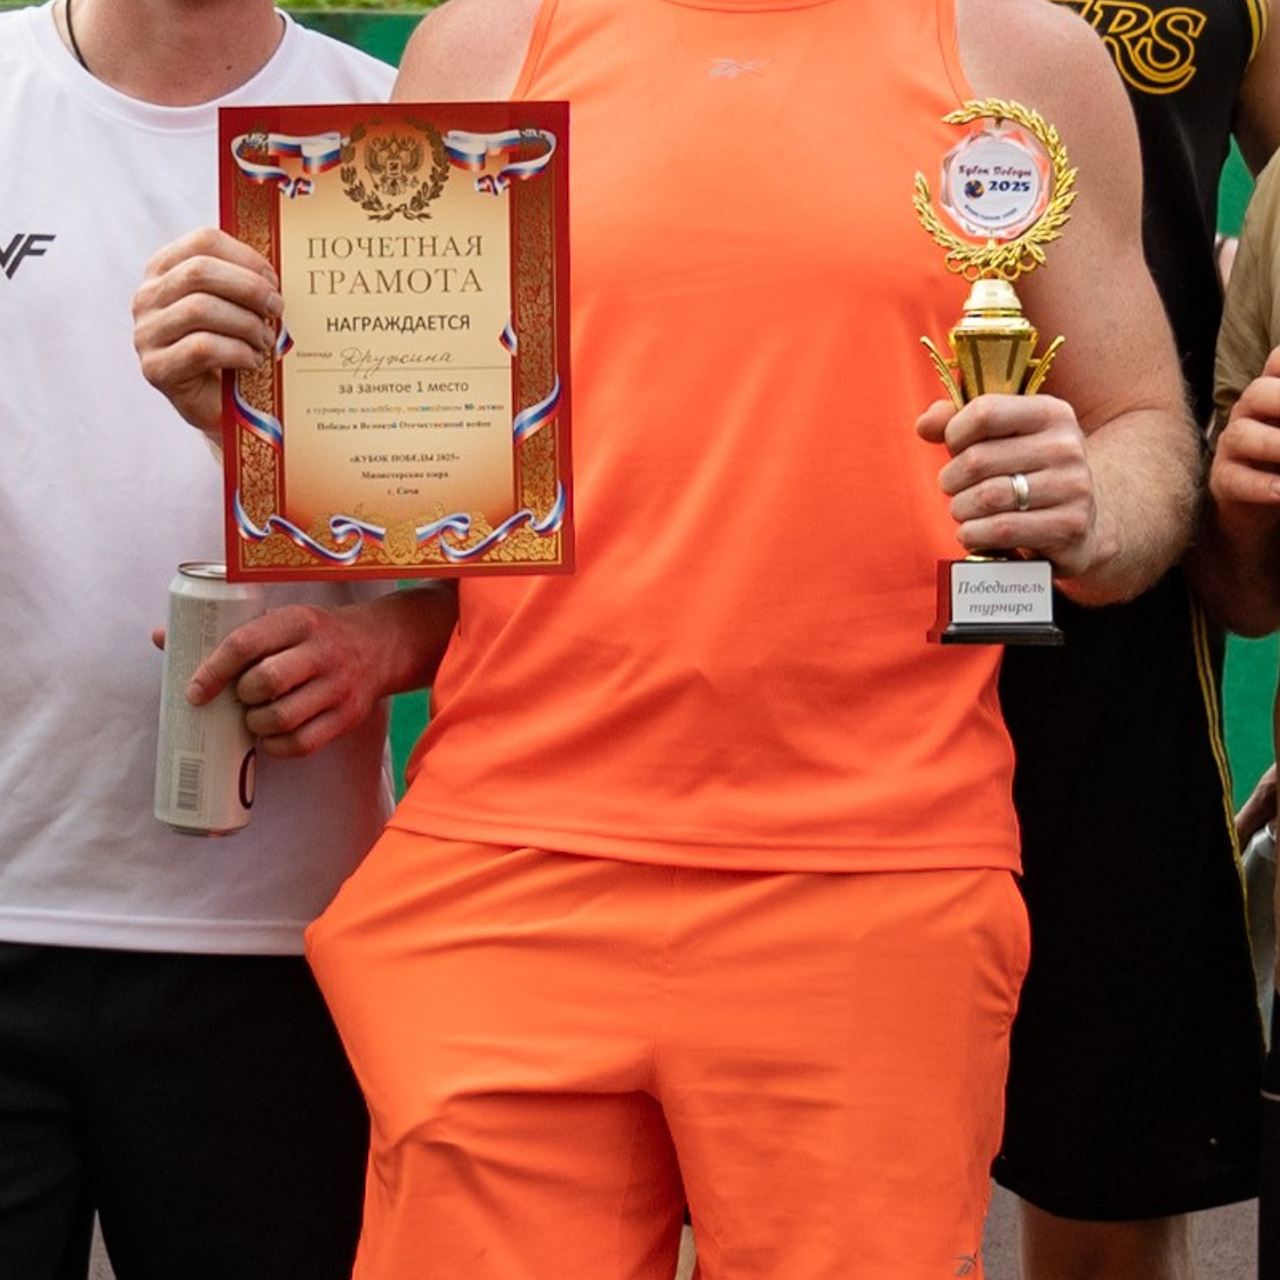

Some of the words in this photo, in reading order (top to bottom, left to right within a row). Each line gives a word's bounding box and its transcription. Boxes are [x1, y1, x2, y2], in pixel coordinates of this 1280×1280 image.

[988, 180, 1030, 192] 2025
[307, 235, 483, 259] ПОЧЕТНАЯ
[307, 268, 484, 296] ГРАМОТА
[326, 314, 471, 333] НАГРАЖДАЕТСЯ
[339, 384, 353, 394] за
[358, 382, 411, 394] занятое
[416, 381, 423, 393] 1
[427, 381, 469, 393] место
[957, 580, 1045, 595] Победитель
[969, 602, 1034, 616] турнира
